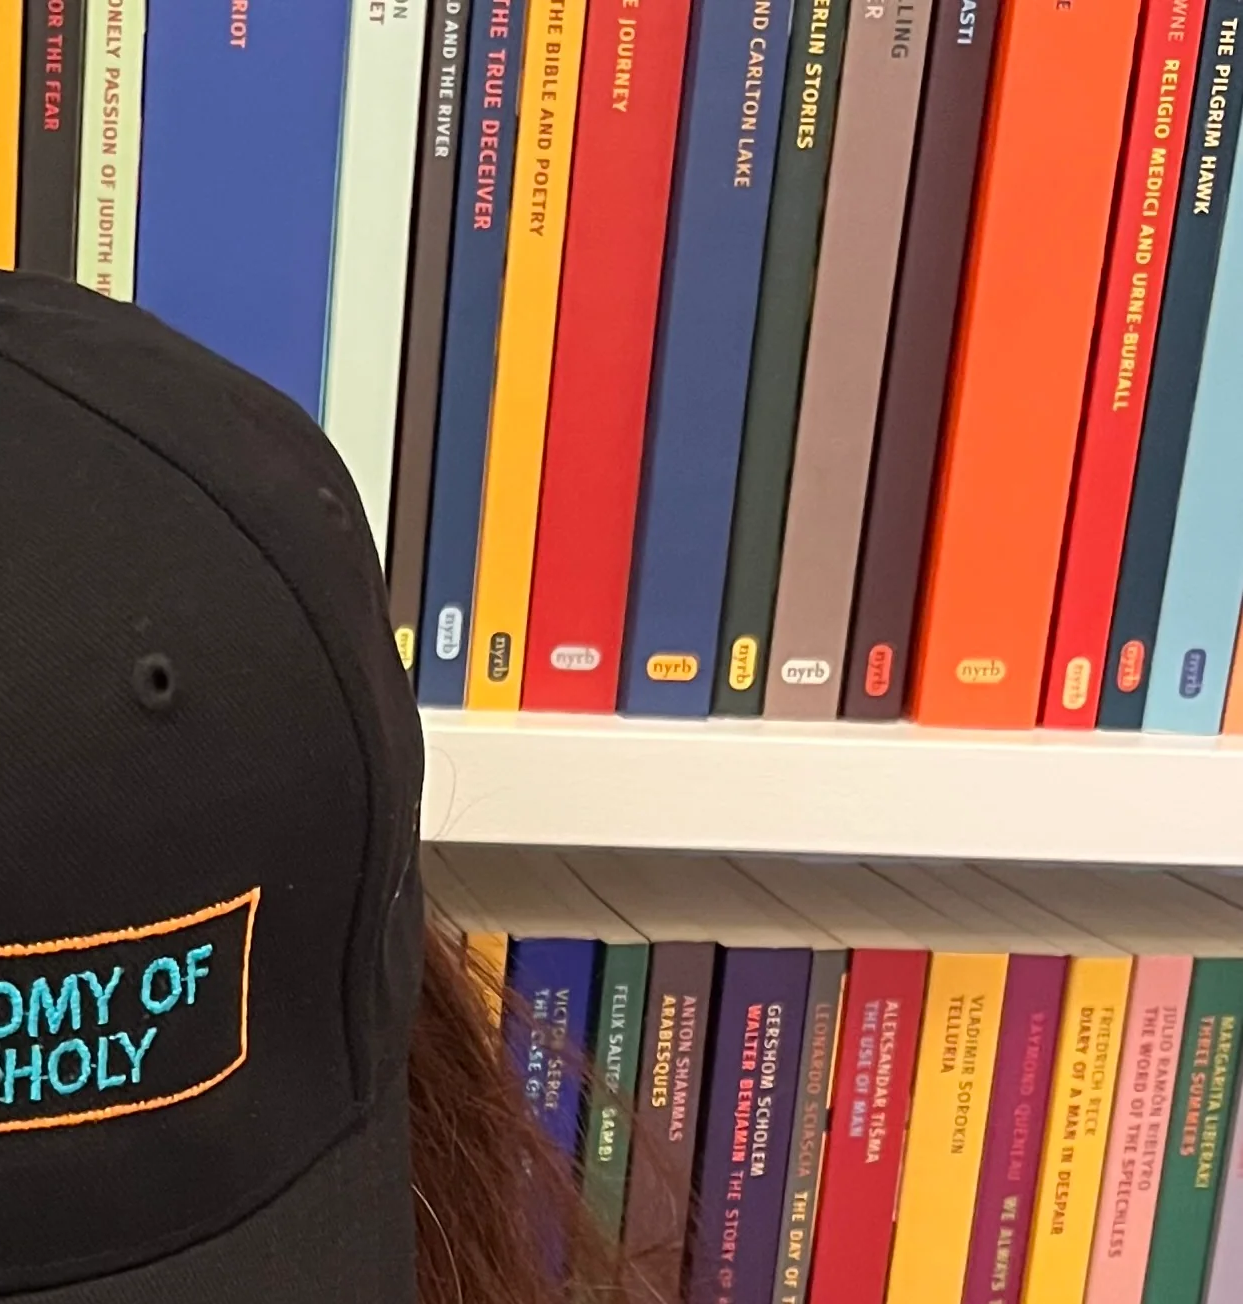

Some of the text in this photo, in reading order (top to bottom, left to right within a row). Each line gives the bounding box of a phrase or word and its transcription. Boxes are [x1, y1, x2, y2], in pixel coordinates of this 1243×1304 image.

[44, 36, 63, 131] THE FEAR
[434, 20, 459, 157] AND THE RIVER
[612, 18, 638, 113] JOURNEY
[733, 38, 767, 188] CARLTON LAKE
[797, 63, 823, 149] STORIES
[473, 0, 511, 230] THE TRUE DECEIVER
[529, 0, 565, 237] THE BIBLE AND POETRY
[1193, 18, 1239, 215] THE PILGRIM HAWK
[97, 67, 121, 264] PASSION OF JUDITH
[1113, 59, 1180, 412] RELIGIO MEDICI AND URNE-BURIALL
[653, 659, 692, 676] nyrb
[734, 643, 751, 685] nyrb
[787, 662, 825, 680] nyrb
[961, 660, 1001, 679] nyrb
[139, 944, 214, 1014] OF
[610, 984, 629, 1029] FELIX
[652, 994, 677, 1108] ARABESQUES
[669, 995, 697, 1143] ANTON SHAMMAS
[807, 1003, 832, 1094] LEONARDO
[849, 1000, 880, 1137] THE USE MAN
[873, 999, 899, 1108] ALEKSANDAR
[940, 994, 965, 1074] TELLURIA
[950, 994, 985, 1155] VLADIMIR SOROKIN
[1084, 1005, 1115, 1138] FRIEDRICH RECK
[1159, 1005, 1178, 1053] JULIO
[1207, 1015, 1236, 1112] MARGARITA
[720, 1004, 763, 1262] WALTER BENJAMIN THE STORY
[750, 1004, 782, 1177] GERSHOM SCHOLEM
[1049, 1005, 1095, 1236] DIARY OF MAN IN DESPAIR
[1108, 1006, 1159, 1259] THE WORD OF THE SPEECHLESS
[1179, 1016, 1216, 1156] THREE SUMMERS
[797, 1102, 821, 1178] SCIASCIA
[1137, 1122, 1161, 1192] RIBEYRO
[787, 1229, 804, 1261] DAY
[791, 1191, 808, 1222] THE
[783, 1267, 799, 1289] OF
[990, 1229, 1014, 1292] ALWAYS
